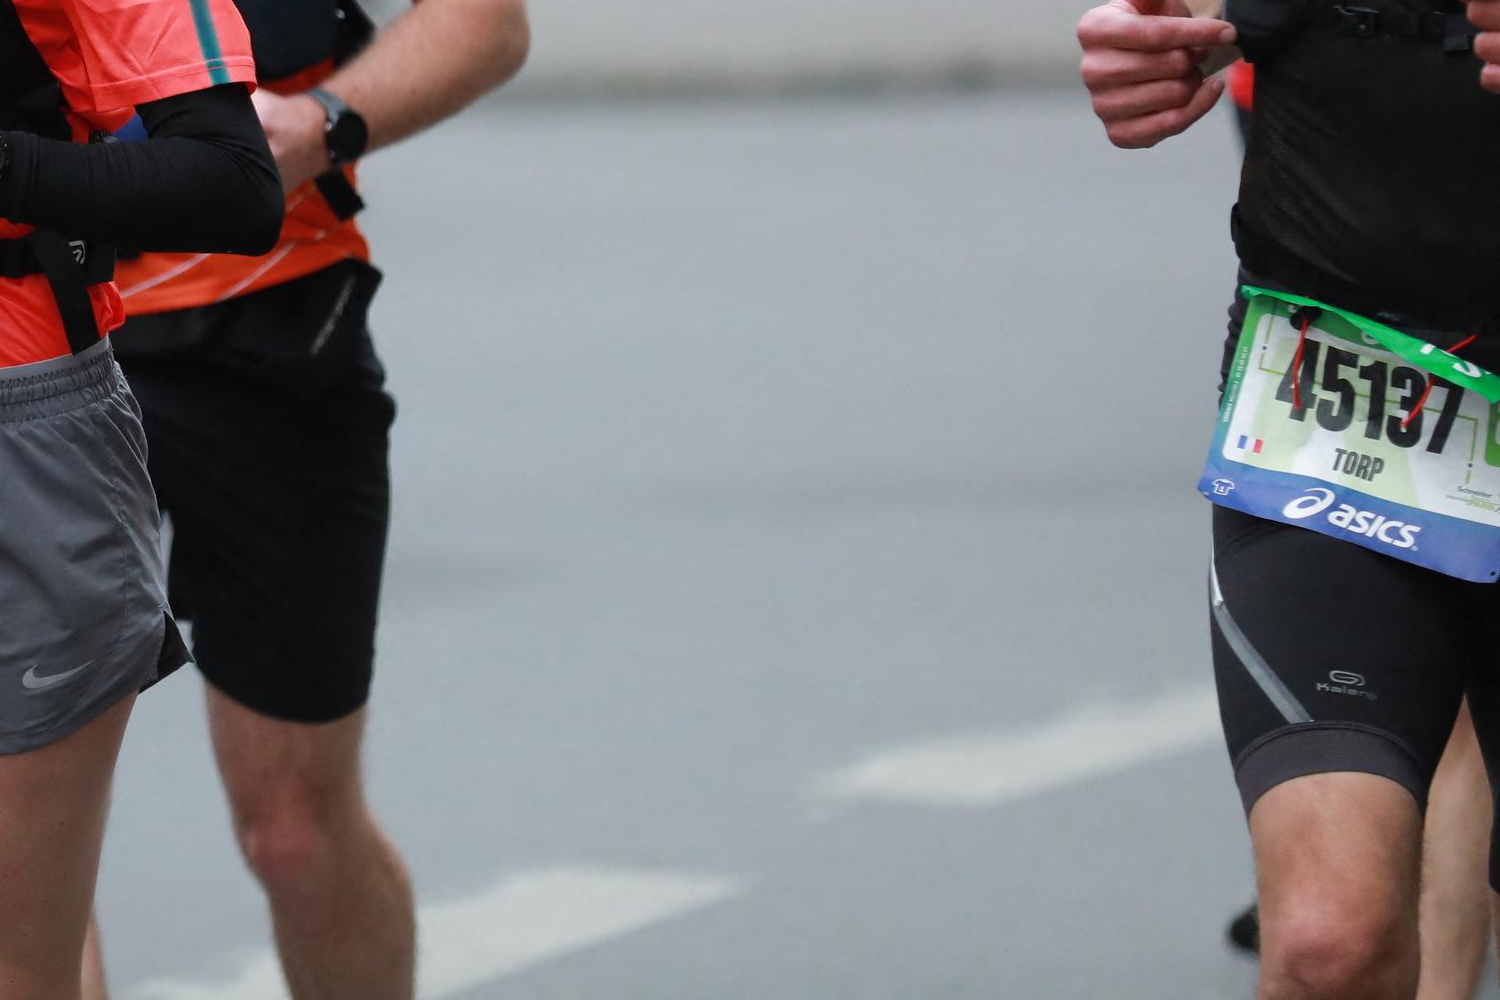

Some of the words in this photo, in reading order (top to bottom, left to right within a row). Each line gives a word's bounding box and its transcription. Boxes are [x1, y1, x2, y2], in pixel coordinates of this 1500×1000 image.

[1275, 337, 1465, 455] 45137
[1332, 447, 1385, 482] TORP
[1327, 502, 1422, 549] asics
